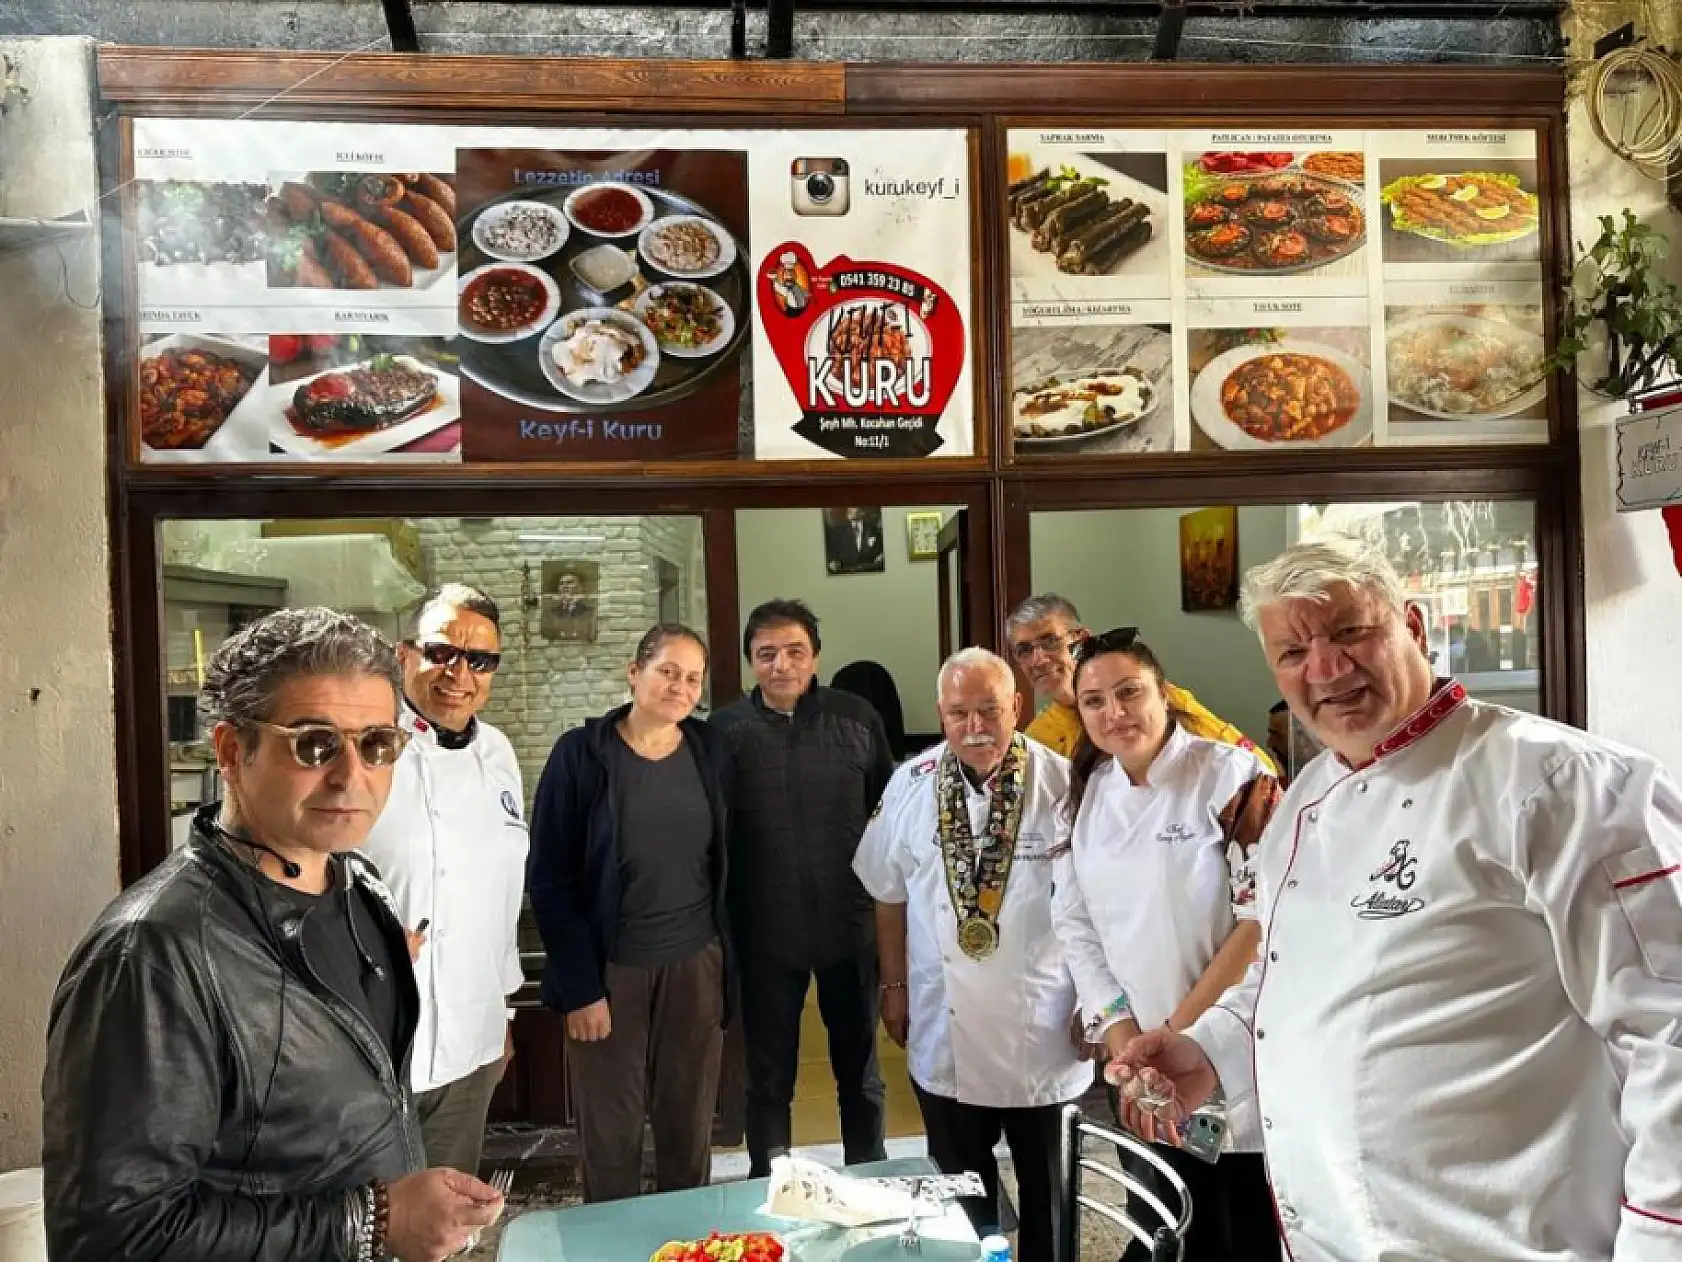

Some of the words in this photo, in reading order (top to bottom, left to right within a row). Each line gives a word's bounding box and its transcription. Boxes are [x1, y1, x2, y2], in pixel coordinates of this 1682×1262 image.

[600, 167, 661, 185] Adresi
[864, 177, 960, 199] kurukeyf_i
[808, 356, 932, 407] KURU
[520, 419, 594, 445] Keyf-i
[603, 419, 662, 440] Kuru
